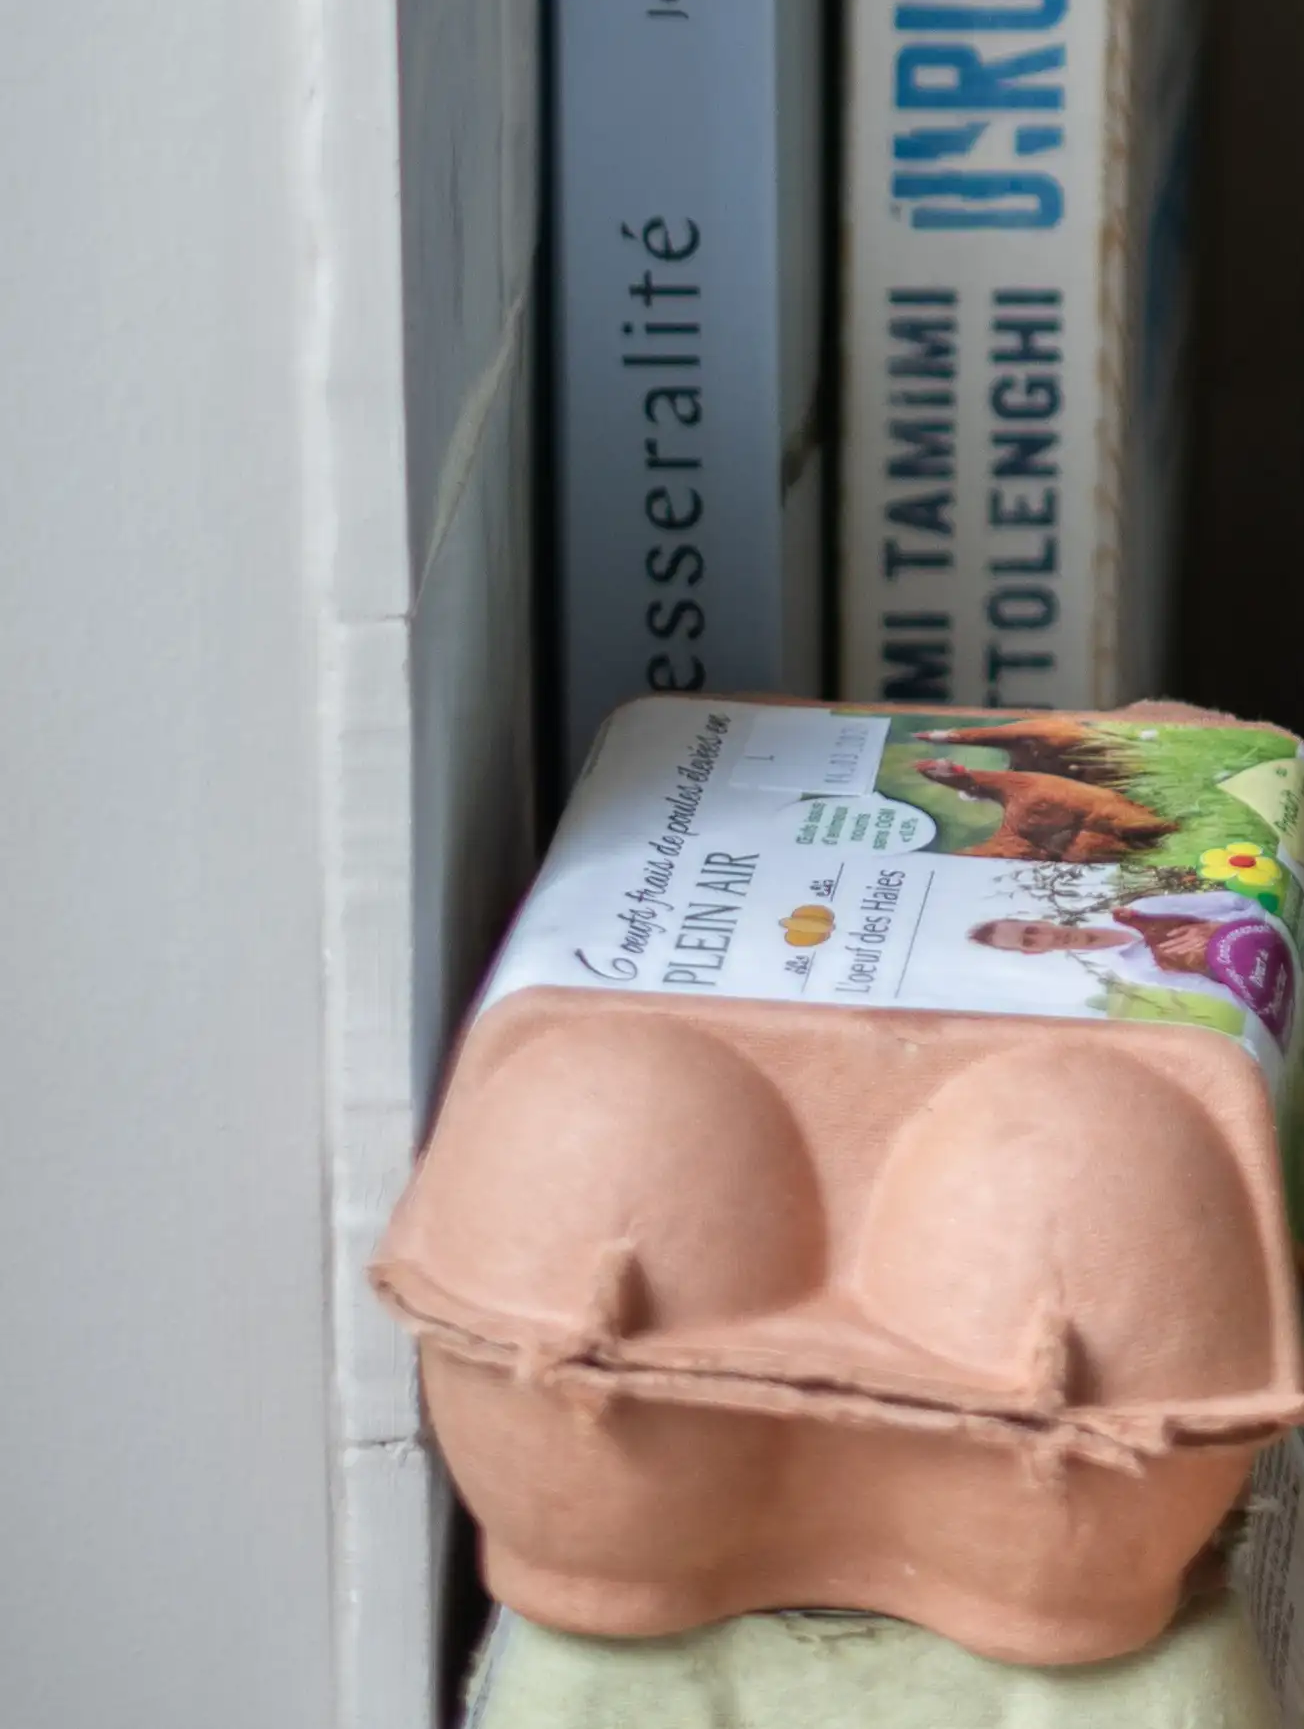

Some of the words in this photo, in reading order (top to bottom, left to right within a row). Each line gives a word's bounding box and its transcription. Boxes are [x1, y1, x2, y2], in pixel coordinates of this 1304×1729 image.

[620, 213, 705, 692] esseralité
[883, 287, 960, 580] TAMIMI
[664, 783, 700, 837] poules
[649, 835, 685, 857] de
[625, 858, 675, 911] frais
[696, 852, 760, 897] AIR
[860, 869, 906, 912] Haies
[662, 902, 742, 986] PLEIN
[848, 915, 892, 944] des
[574, 948, 638, 981] 6
[835, 945, 883, 993] L'oeuf
